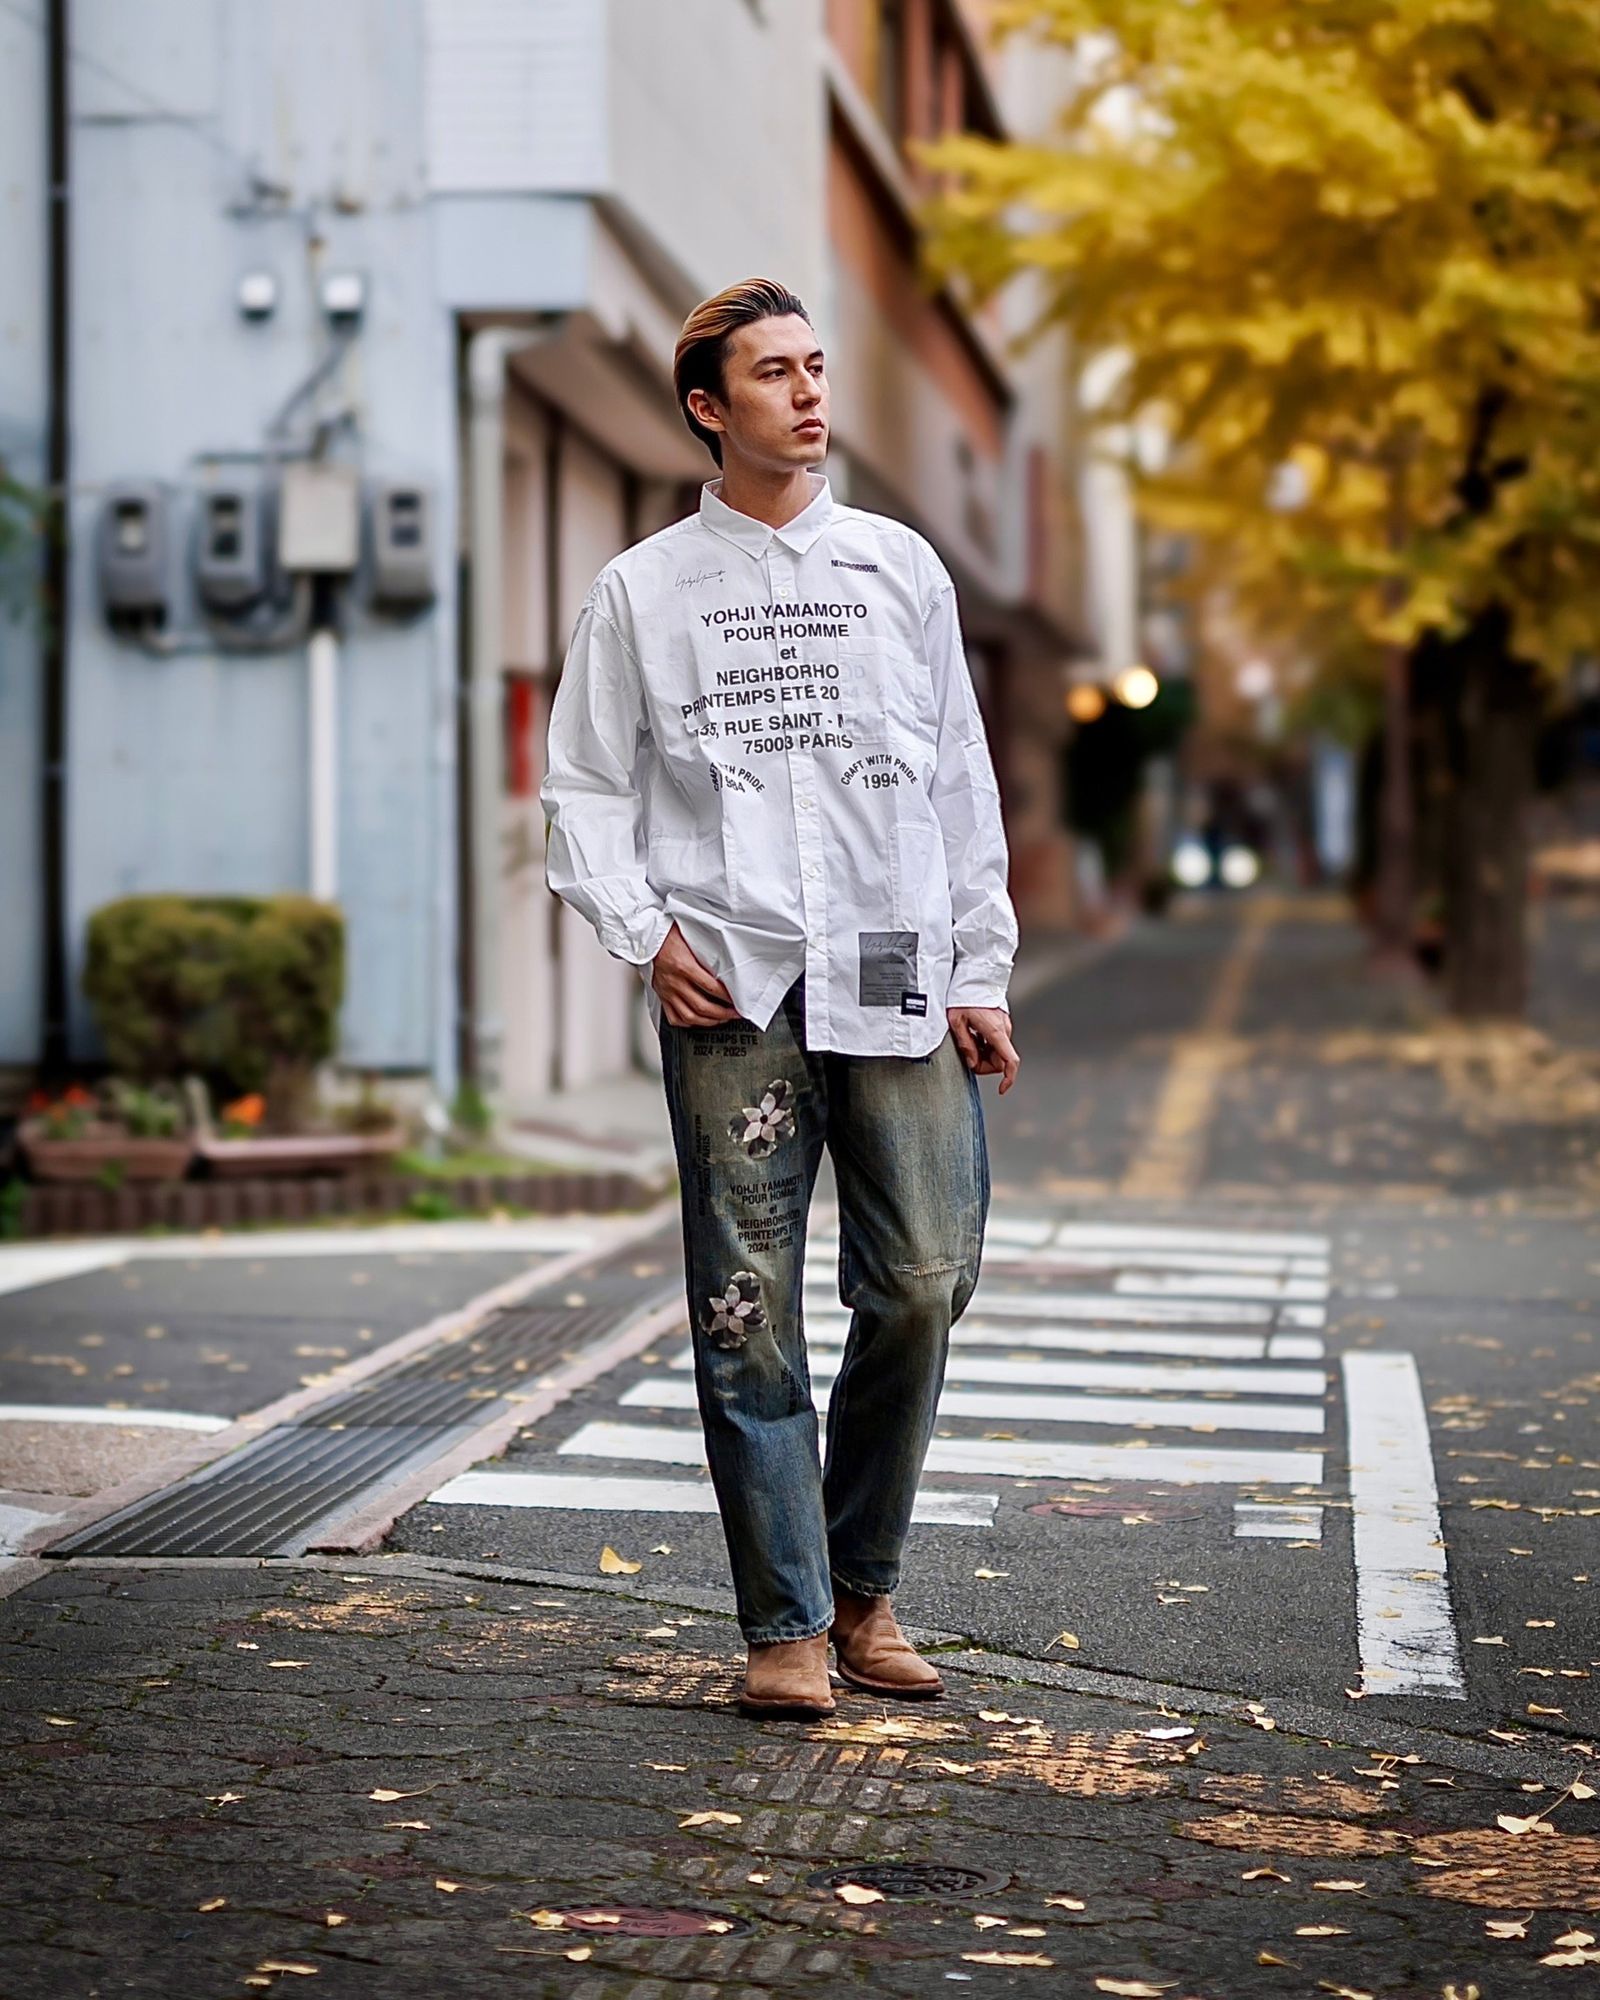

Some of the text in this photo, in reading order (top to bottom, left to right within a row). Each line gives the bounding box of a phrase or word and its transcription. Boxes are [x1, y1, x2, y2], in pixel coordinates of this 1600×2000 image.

[831, 559, 880, 573] NEORHOOD.
[700, 603, 868, 627] YOHJI YAMAMOTO
[723, 623, 850, 643] POUR HOMME
[780, 646, 798, 660] et
[681, 688, 776, 719] PRINTEMPS
[781, 684, 817, 702] ETE
[724, 718, 764, 736] RUE
[768, 712, 823, 731] SAINT
[743, 733, 853, 755] 75003 PARIS
[841, 754, 918, 786] CRAFT WITH PRIDE
[738, 768, 766, 793] PRIDE
[862, 772, 900, 789] 1994
[740, 1034, 758, 1045] ETE
[723, 1046, 747, 1057] 2025
[730, 1183, 759, 1195] YOHJI
[742, 1193, 768, 1205] POUR
[747, 1241, 770, 1254] 2024
